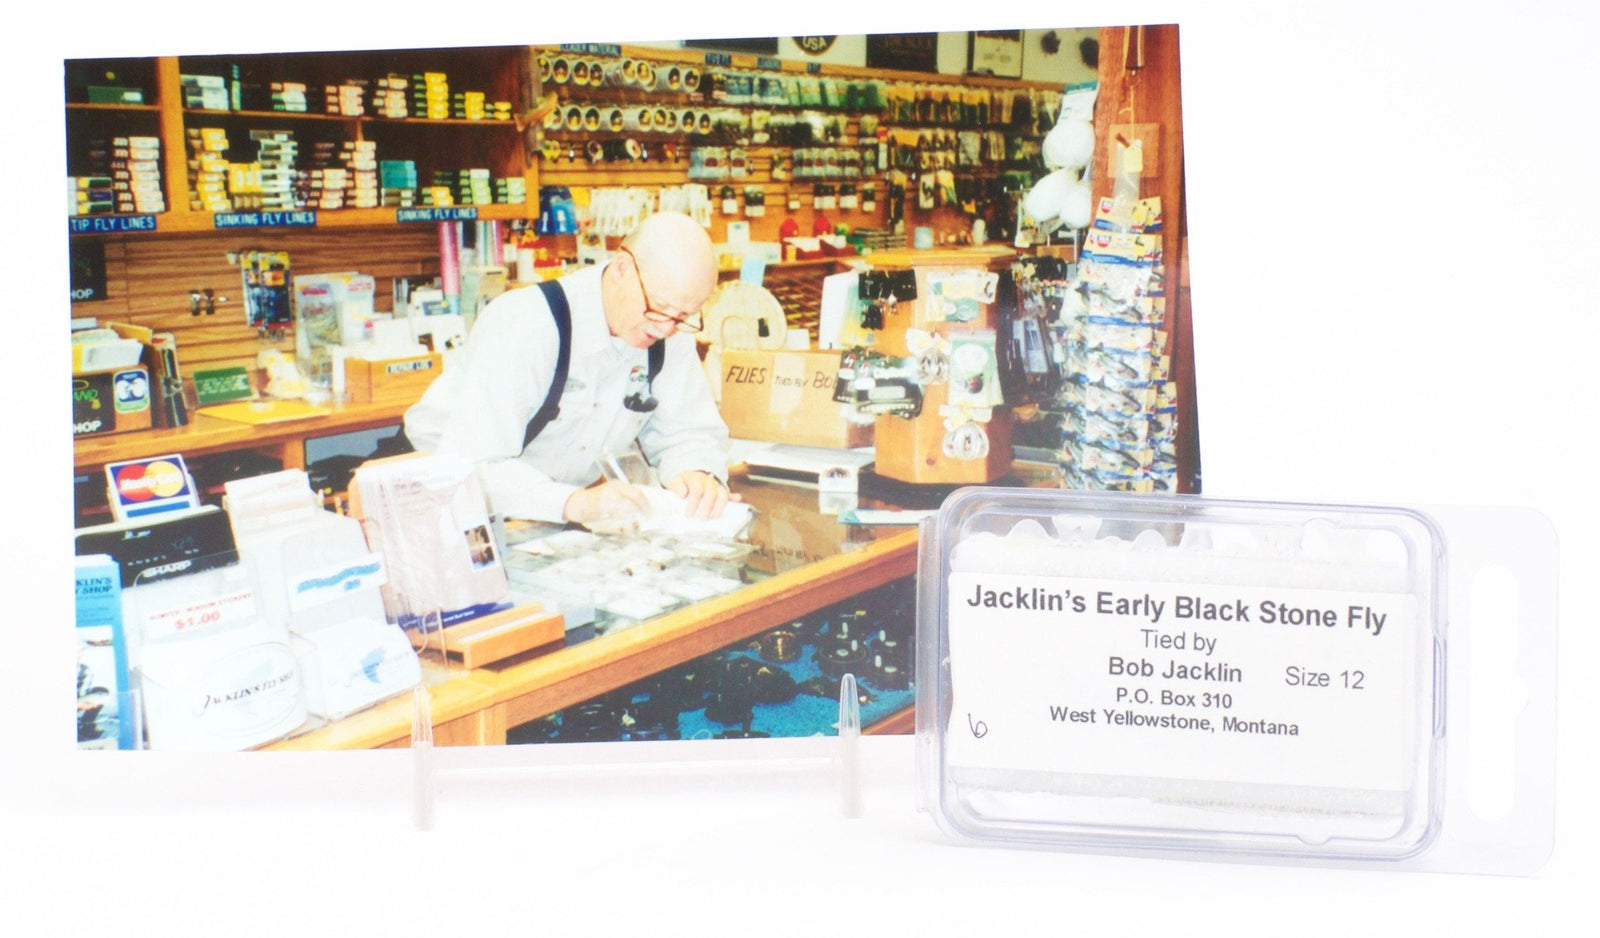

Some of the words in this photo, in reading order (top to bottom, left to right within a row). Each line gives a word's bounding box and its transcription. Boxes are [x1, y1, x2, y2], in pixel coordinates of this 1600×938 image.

[802, 37, 827, 51] USA
[72, 218, 90, 232] TIP
[94, 217, 115, 231] FLY
[121, 216, 155, 230] LINES
[215, 212, 259, 227] SINKING
[262, 212, 281, 226] FLY
[285, 211, 315, 225] LINES
[397, 208, 432, 222] SINKING
[434, 207, 452, 220] FLY
[453, 206, 477, 219] LINES
[725, 365, 767, 385] FLIES
[142, 559, 192, 578] SHARP
[82, 585, 112, 595] SHOP
[174, 609, 220, 630] $1.00
[967, 585, 1087, 613] Jacklin’s
[1097, 591, 1166, 624] Early
[1175, 596, 1250, 623] Black
[1259, 600, 1338, 628] Stone
[1347, 605, 1387, 637] Fly
[1140, 628, 1187, 651] Tied
[1193, 632, 1217, 656] by
[1108, 657, 1154, 678] Bob
[1161, 660, 1242, 683] Jacklin
[1285, 665, 1330, 688] Size
[1340, 670, 1365, 690] 12
[1116, 687, 1154, 704] P.O.
[1160, 689, 1197, 707] Box
[1201, 692, 1233, 709] 310
[1049, 705, 1097, 724] West
[1103, 708, 1215, 733] Yellowstone,
[1222, 716, 1299, 736] Montana
